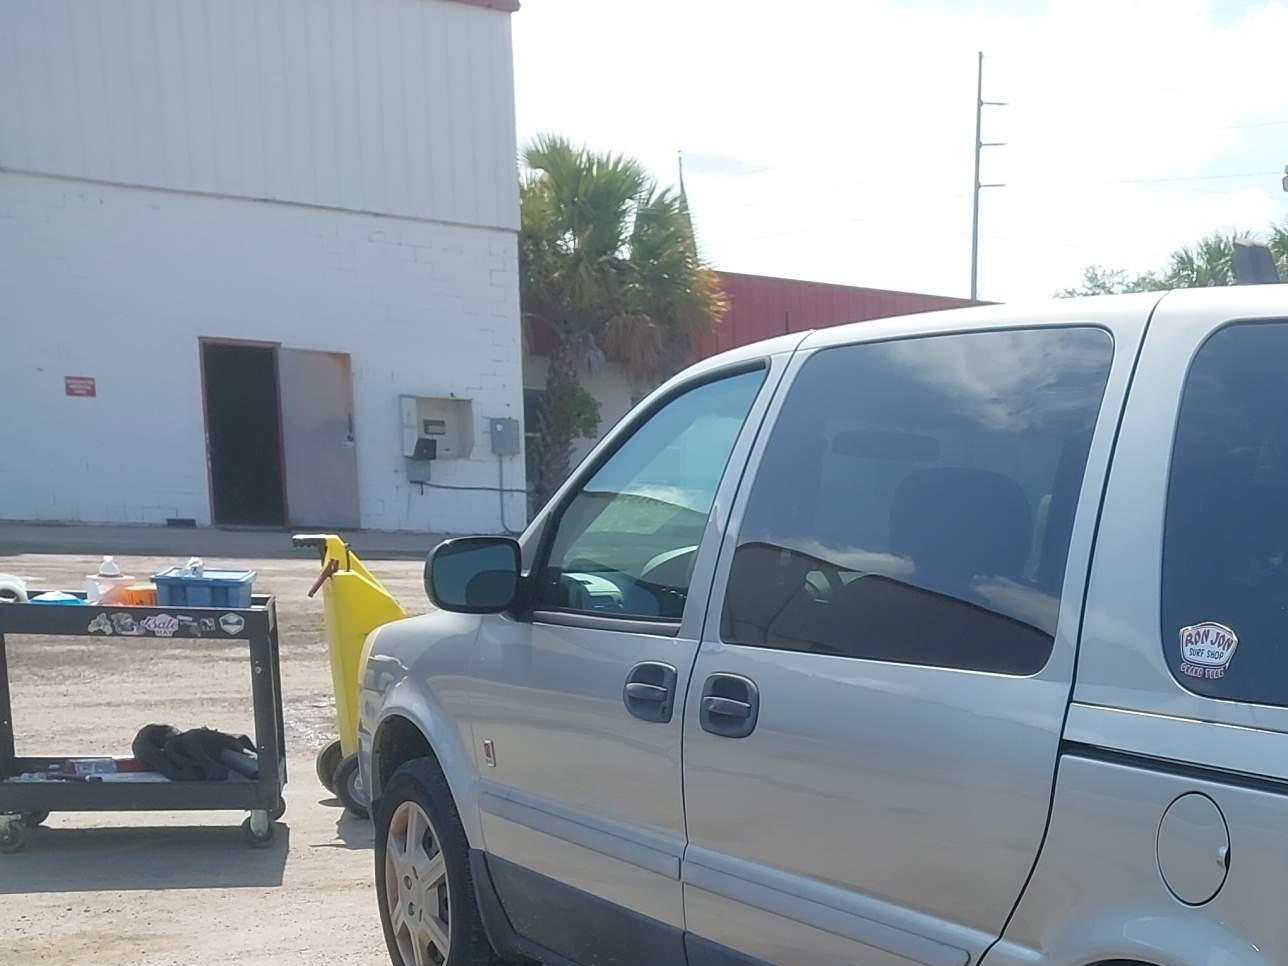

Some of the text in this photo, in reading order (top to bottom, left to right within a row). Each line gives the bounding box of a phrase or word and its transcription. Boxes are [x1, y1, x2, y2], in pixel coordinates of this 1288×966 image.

[1185, 629, 1234, 652] RON JON
[1188, 647, 1224, 660] SURF SHOP
